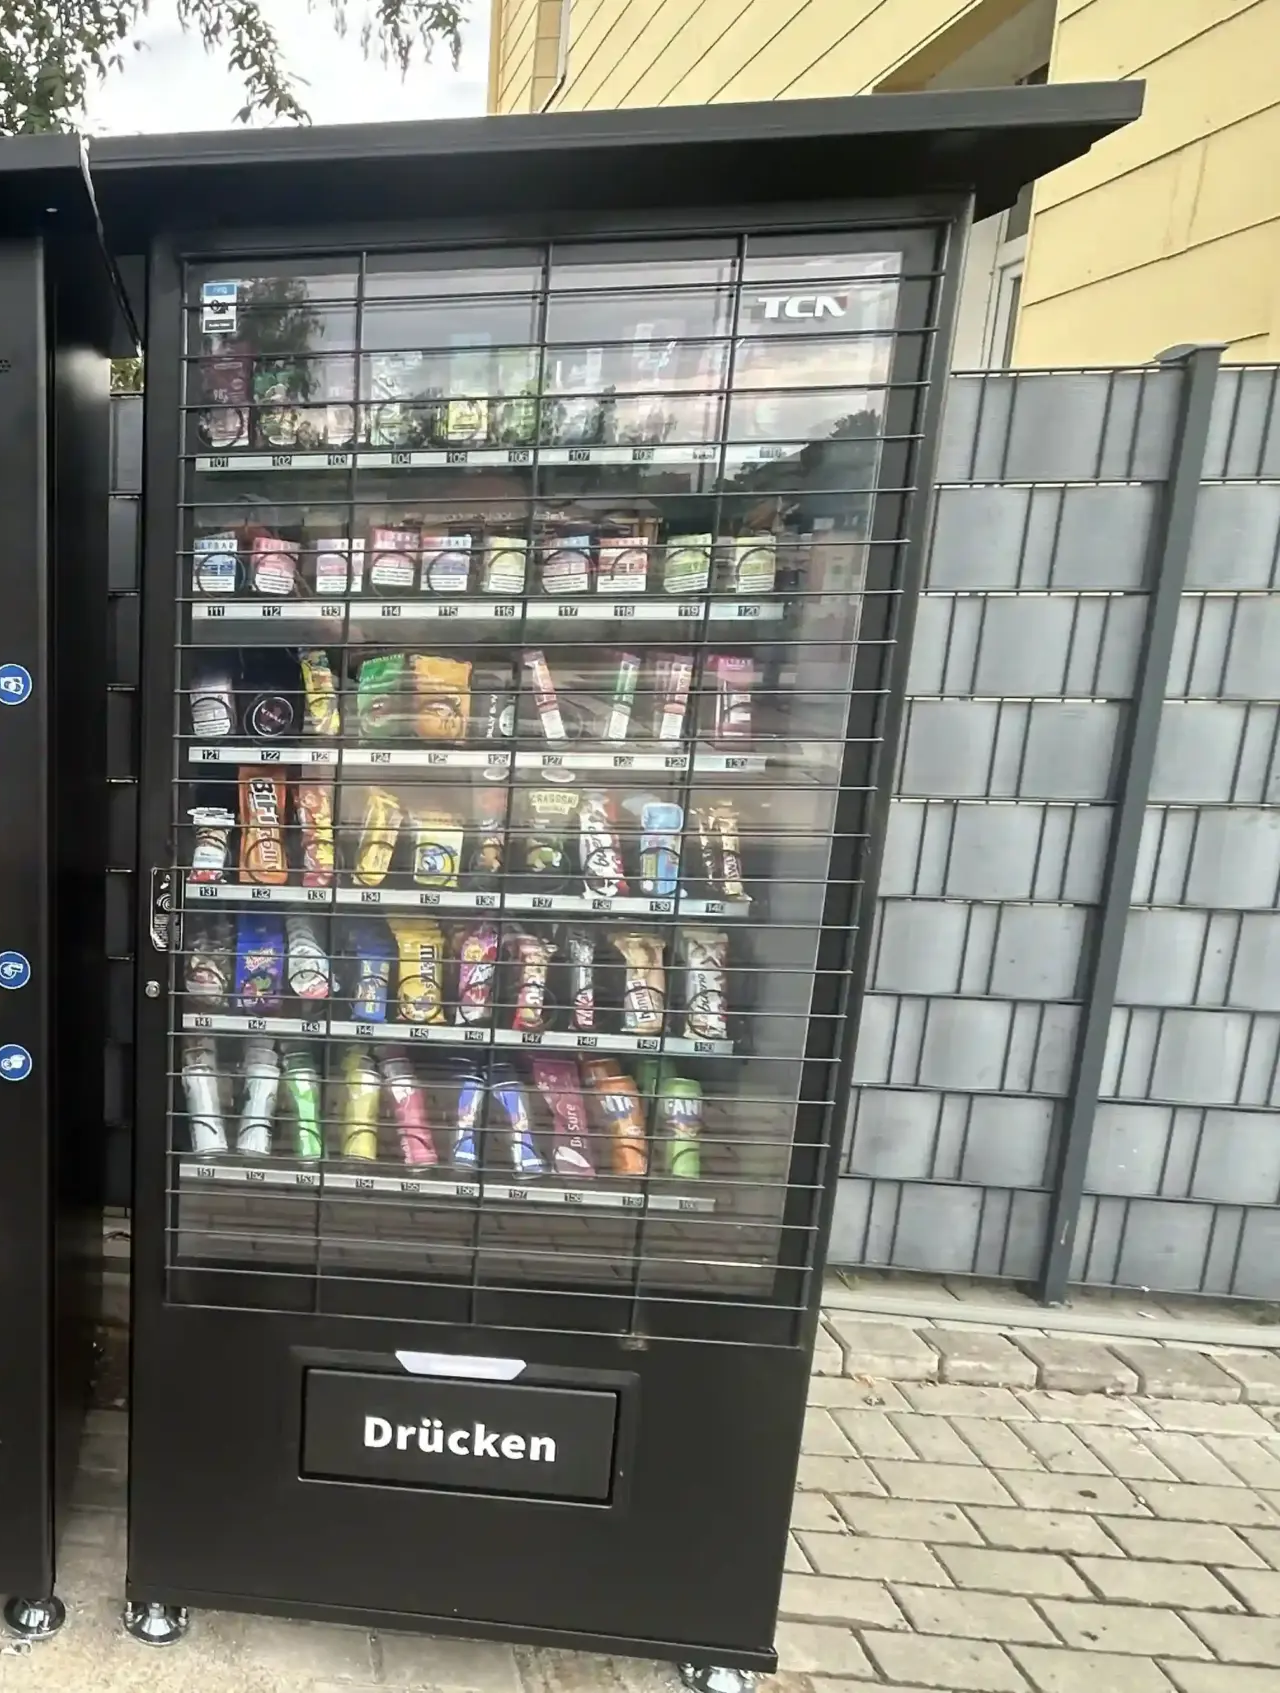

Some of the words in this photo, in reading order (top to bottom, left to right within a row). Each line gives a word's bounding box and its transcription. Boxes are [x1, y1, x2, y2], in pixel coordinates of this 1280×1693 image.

[758, 295, 847, 318] TCN
[328, 455, 346, 465] 103
[393, 453, 411, 464] 104
[448, 453, 467, 463] 105
[510, 451, 529, 462] 106
[571, 450, 590, 460] 107
[211, 457, 228, 467] 101
[273, 456, 291, 466] 102
[209, 606, 223, 616] 111
[263, 606, 280, 616] 112
[322, 606, 340, 616] 113
[382, 606, 400, 616] 114
[439, 606, 457, 616] 115
[496, 606, 514, 616] 116
[560, 606, 578, 616] 117
[615, 606, 634, 616] 118
[679, 606, 699, 616] 119
[739, 606, 759, 616] 120
[203, 750, 219, 759] 121
[262, 751, 280, 760] 122
[372, 753, 390, 762] 124
[544, 755, 561, 765] 127
[666, 758, 686, 767] 129
[727, 759, 747, 768] 130
[200, 887, 217, 896] 131
[253, 889, 270, 898] 132
[308, 891, 326, 900] 133
[362, 892, 380, 901] 134
[421, 894, 439, 904] 135
[533, 898, 552, 907] 137
[593, 900, 612, 909] 138
[651, 902, 669, 911] 139
[195, 1018, 212, 1027] 141
[249, 1020, 266, 1029] 142
[302, 1023, 319, 1032] 143
[357, 1026, 374, 1035] 144
[410, 1028, 428, 1038] 145
[465, 1031, 483, 1040] 146
[523, 1034, 541, 1043] 147
[578, 1037, 596, 1046] 148
[638, 1039, 657, 1049] 149
[567, 1104, 580, 1130] Sure
[356, 1179, 373, 1188] 154
[364, 1416, 556, 1462] Drücken
